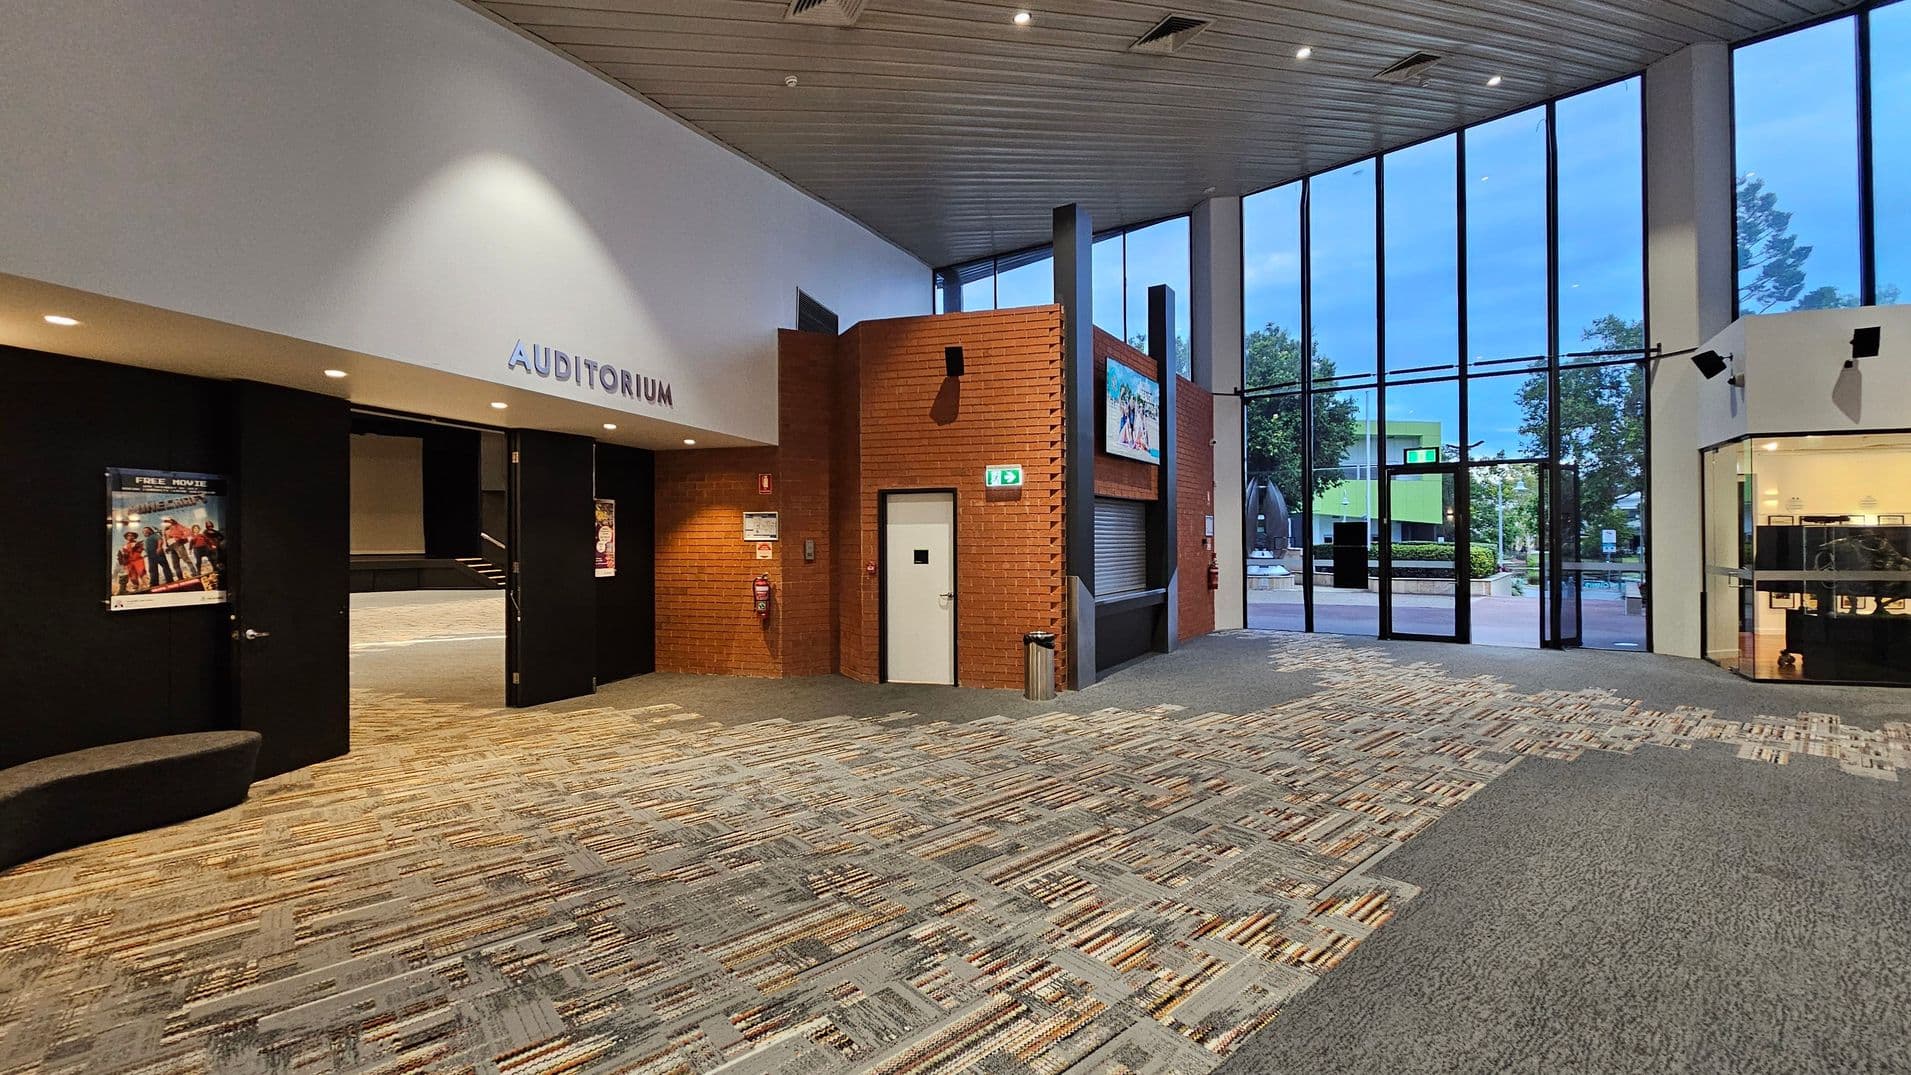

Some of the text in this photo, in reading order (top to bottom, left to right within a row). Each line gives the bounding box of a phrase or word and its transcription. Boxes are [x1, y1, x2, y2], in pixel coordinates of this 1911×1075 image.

[508, 339, 673, 408] AUDITORIUM
[135, 476, 208, 487] FREE MOVIE
